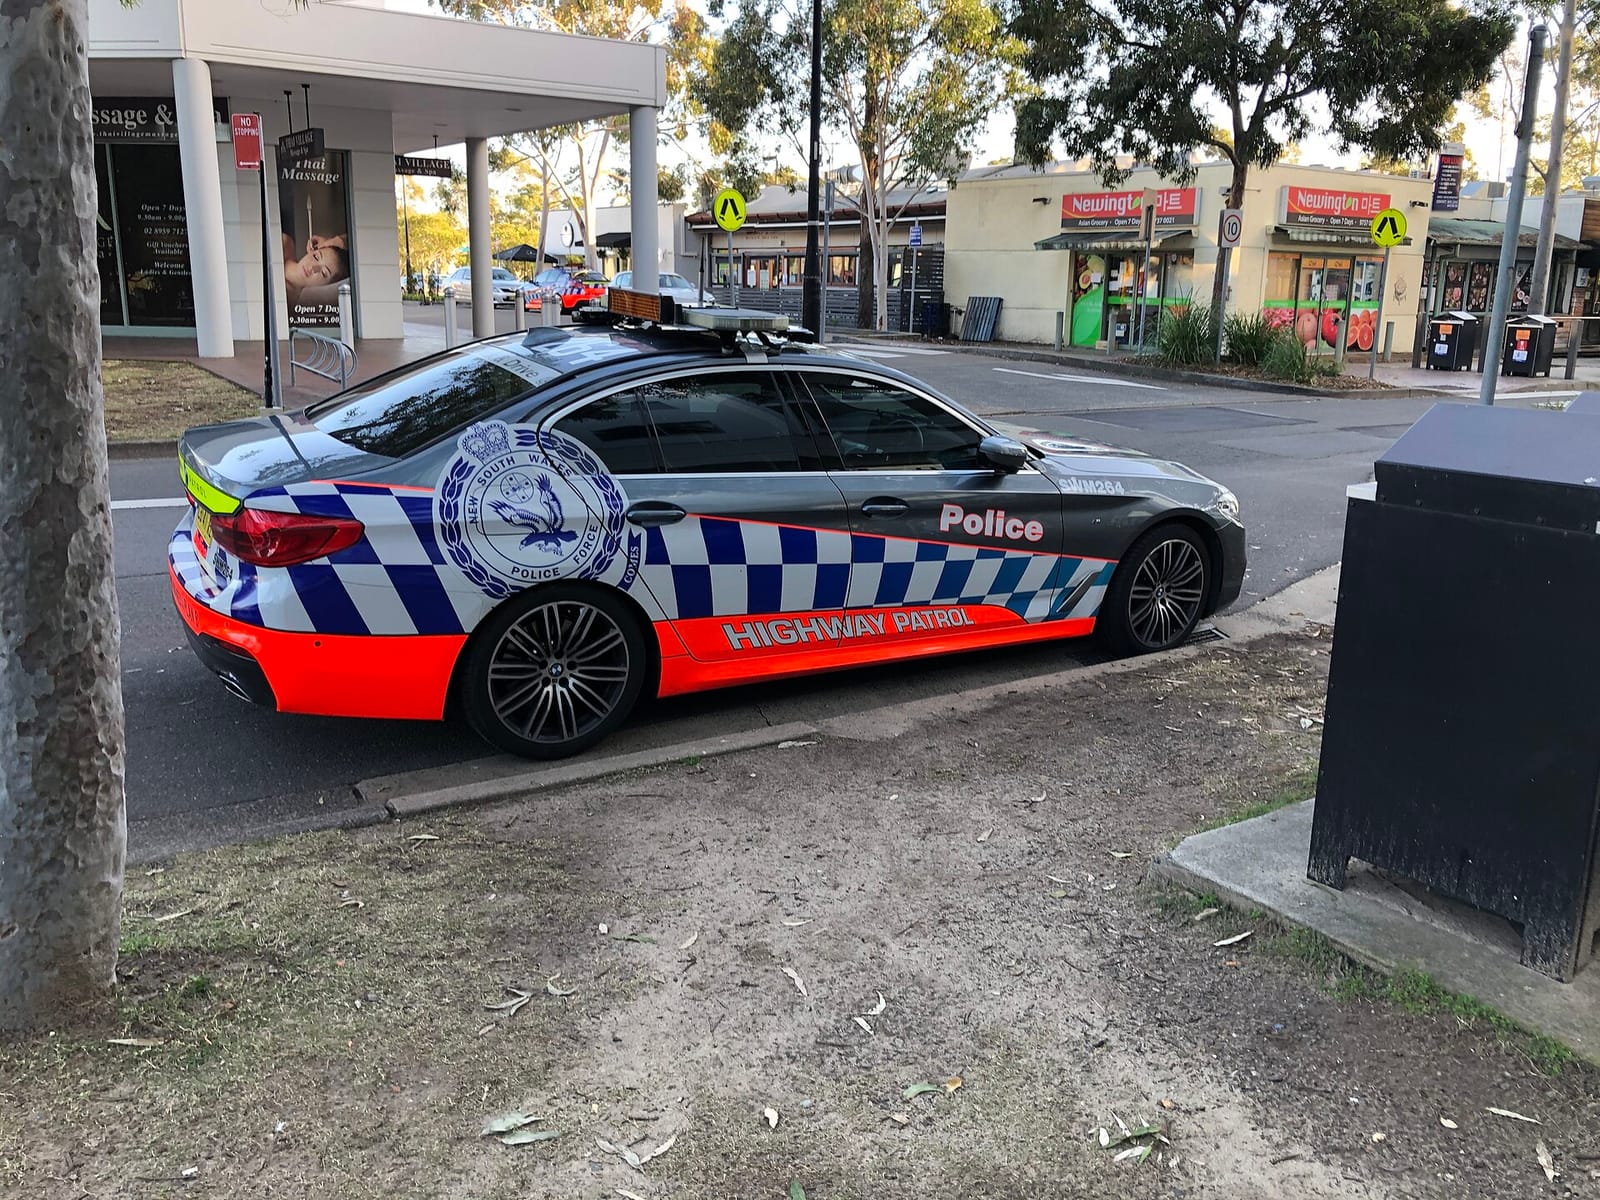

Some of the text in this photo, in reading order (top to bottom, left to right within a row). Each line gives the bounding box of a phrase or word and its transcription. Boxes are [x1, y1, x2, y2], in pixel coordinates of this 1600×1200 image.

[155, 104, 174, 125] &
[241, 117, 251, 126] NO
[234, 127, 259, 136] STOPPING
[404, 158, 450, 170] VILLAGE
[281, 168, 340, 184] Massage
[424, 168, 437, 176] Spa
[141, 204, 160, 212] Open
[1297, 189, 1382, 214] Newington 마트
[1091, 219, 1109, 227] Grocery
[1114, 218, 1127, 226] Open
[1298, 215, 1309, 223] Asian
[1309, 216, 1325, 224] Grocery
[1330, 217, 1341, 225] Open
[1344, 217, 1354, 225] Days
[1227, 222, 1238, 236] 10
[294, 304, 316, 314] Open
[318, 304, 323, 313] 7
[289, 316, 317, 324] 9.30am
[503, 359, 539, 378] Drive
[468, 454, 572, 525] NEW SOUTH WALES
[1058, 476, 1125, 496] SWM264
[939, 503, 1044, 542] Police
[511, 524, 599, 580] POLICE FORCE
[722, 607, 975, 651] HIGHWAY PATROL
